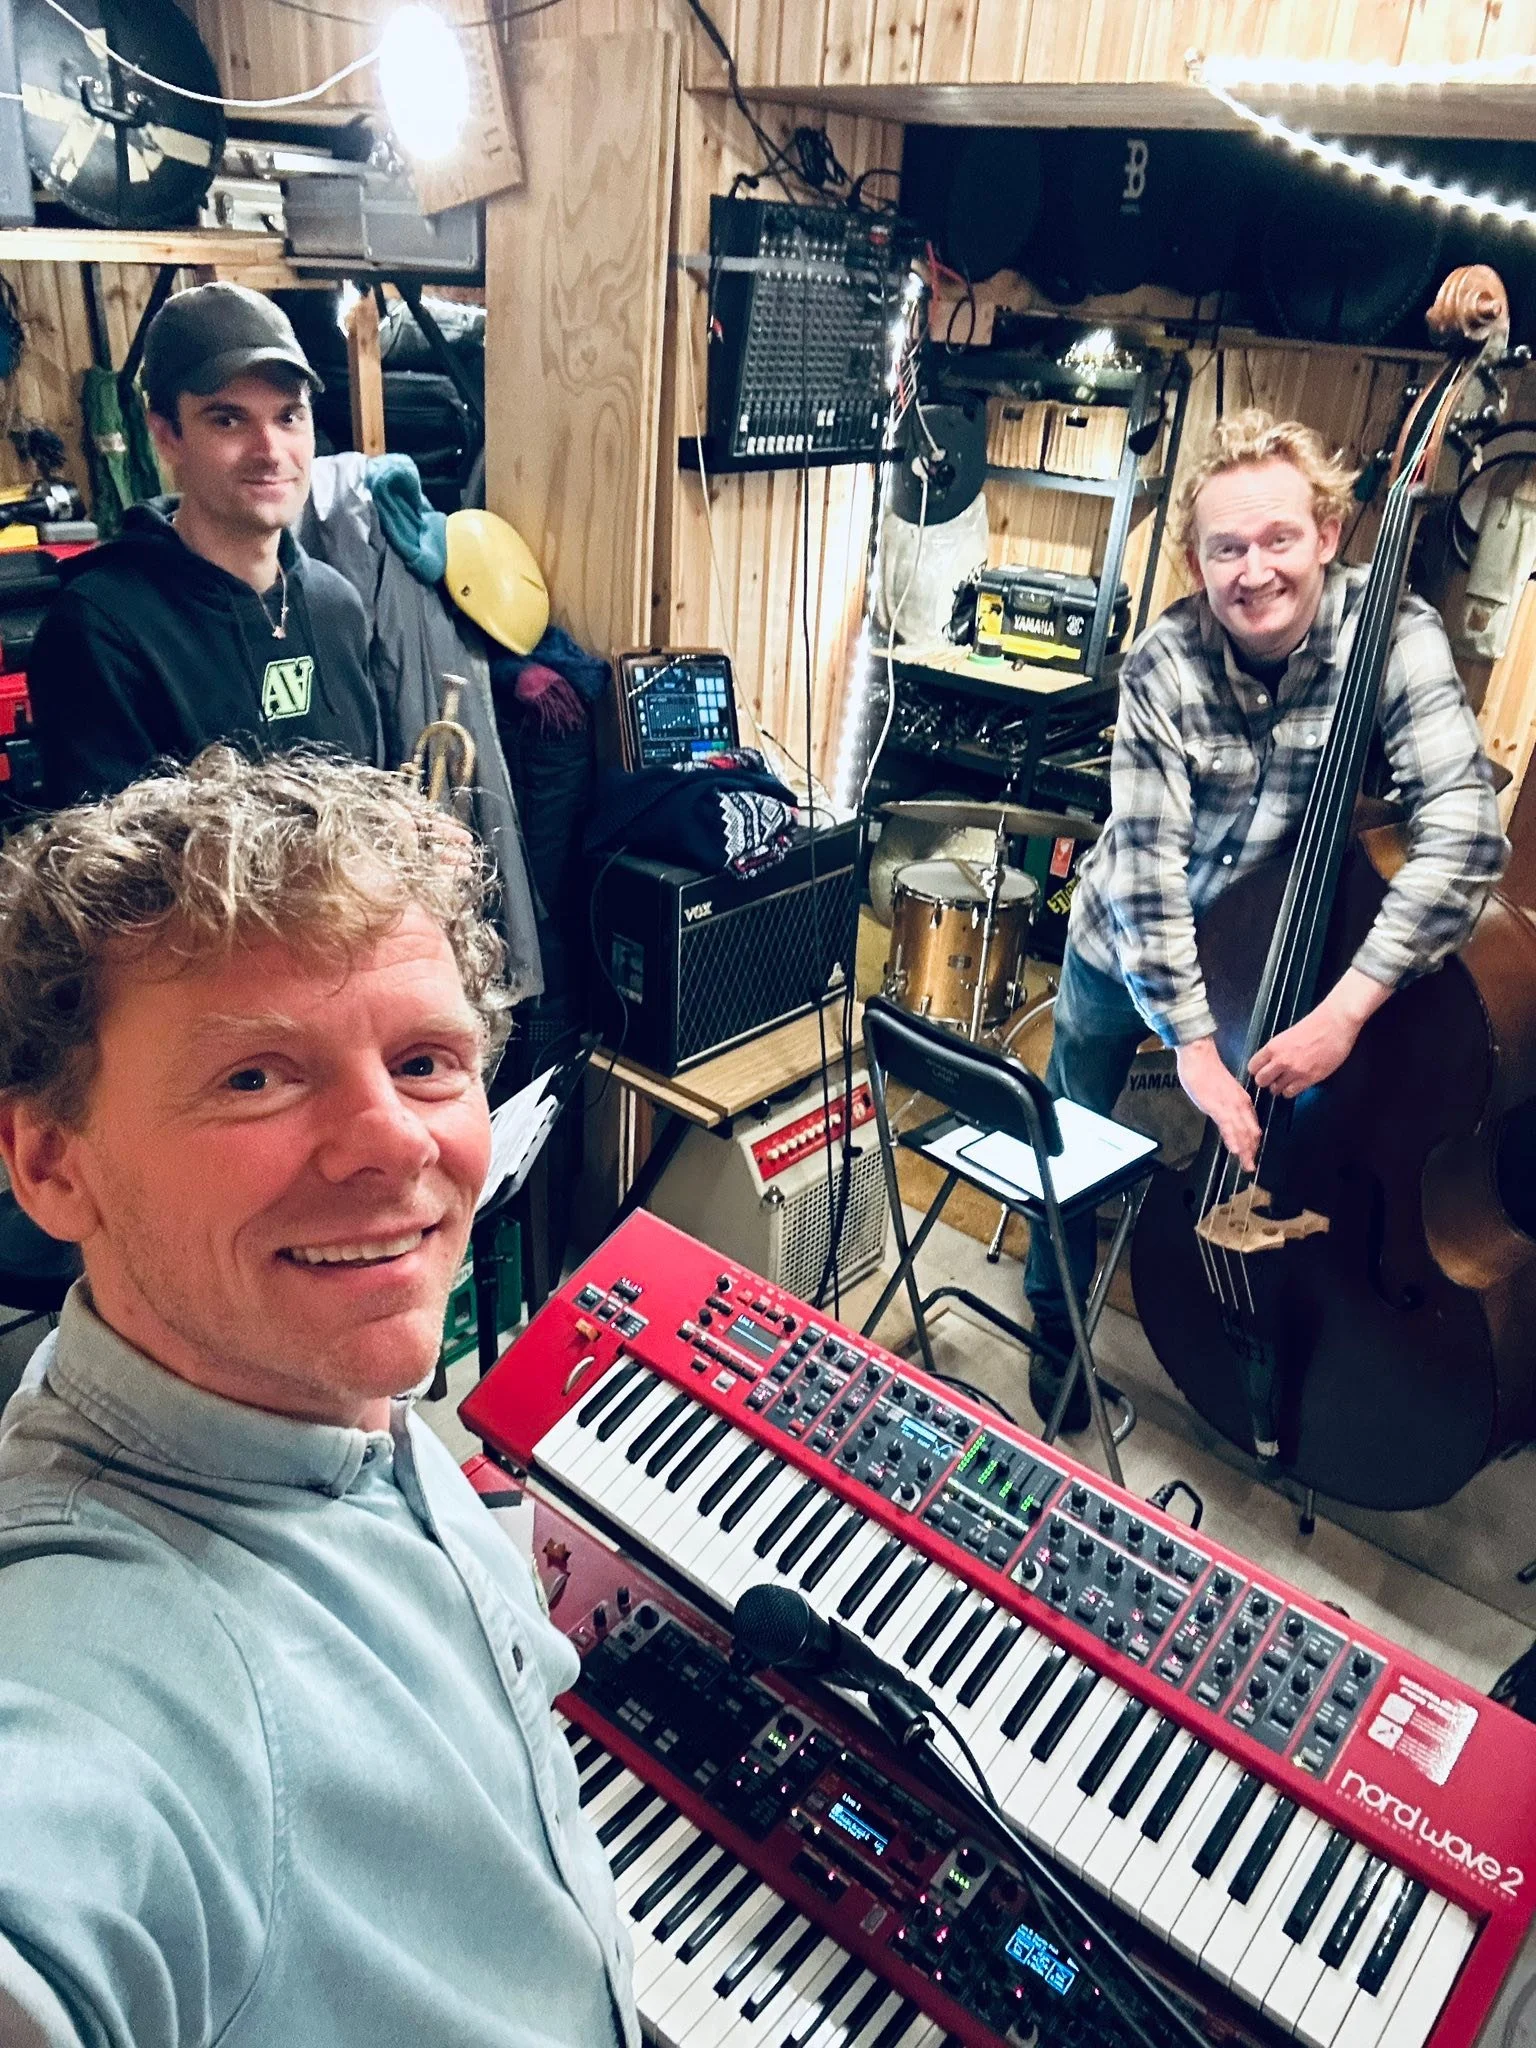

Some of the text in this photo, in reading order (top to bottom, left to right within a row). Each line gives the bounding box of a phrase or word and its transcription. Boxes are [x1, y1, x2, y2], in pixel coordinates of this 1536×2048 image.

[1123, 138, 1149, 199] B
[1014, 614, 1055, 637] YAMAHA
[684, 901, 713, 922] VOX
[1129, 1073, 1181, 1092] YAMAH
[1341, 1769, 1525, 1897] nord wave 2
